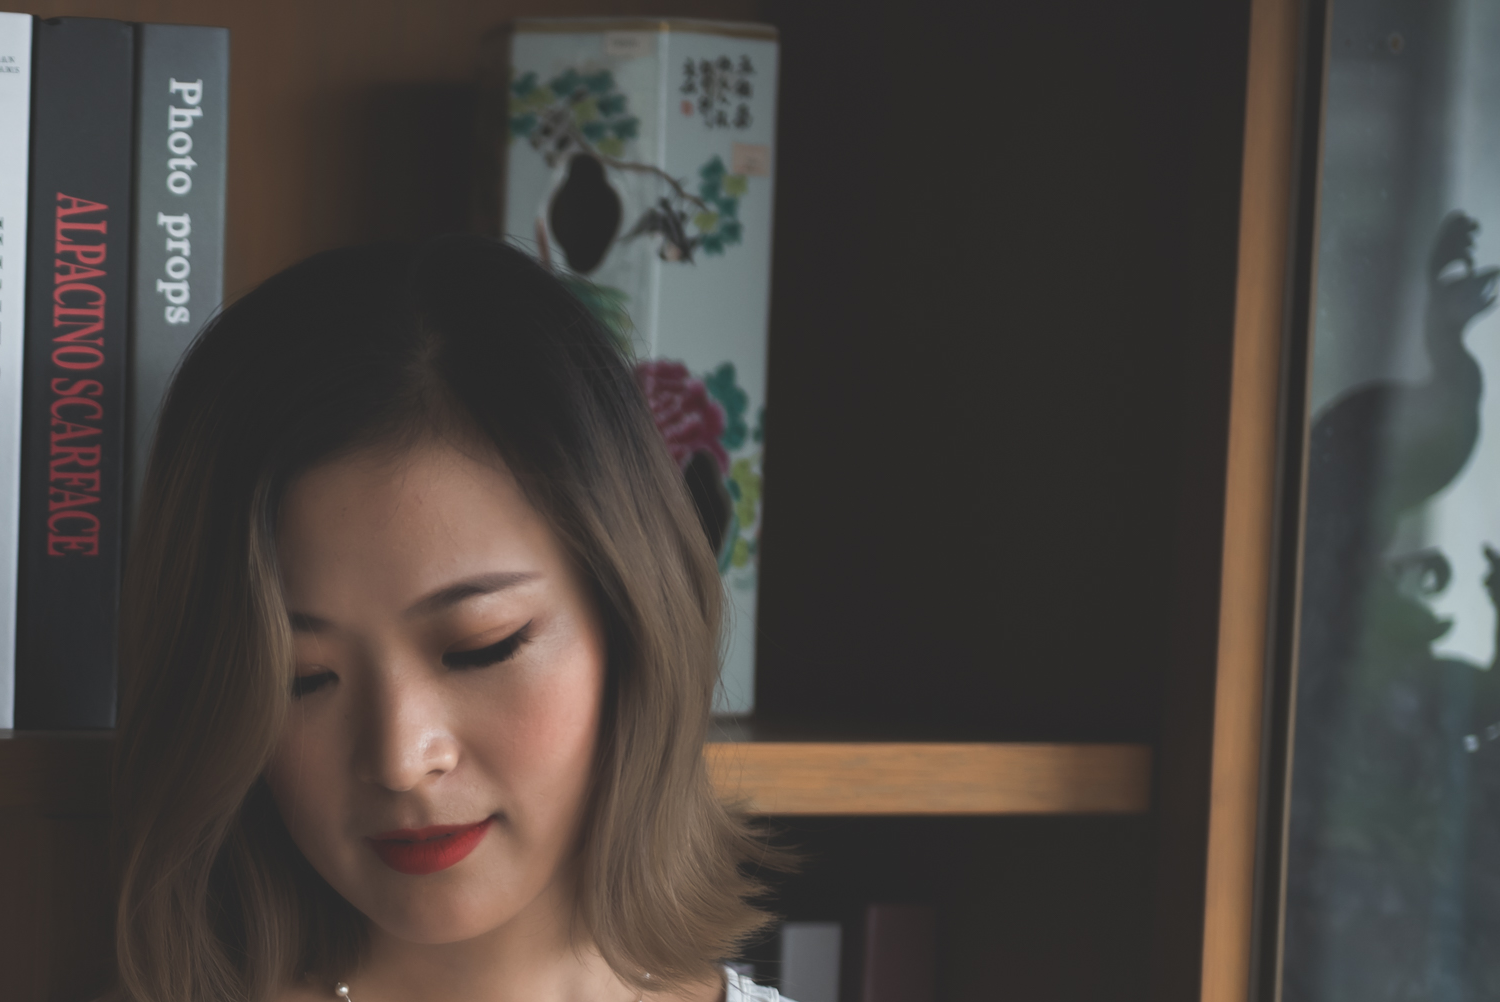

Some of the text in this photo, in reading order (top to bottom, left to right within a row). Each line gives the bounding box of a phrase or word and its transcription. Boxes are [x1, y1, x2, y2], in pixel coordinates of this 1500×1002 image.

[156, 77, 203, 324] Photo props
[47, 191, 108, 557] ALPACINO SCARFACE
